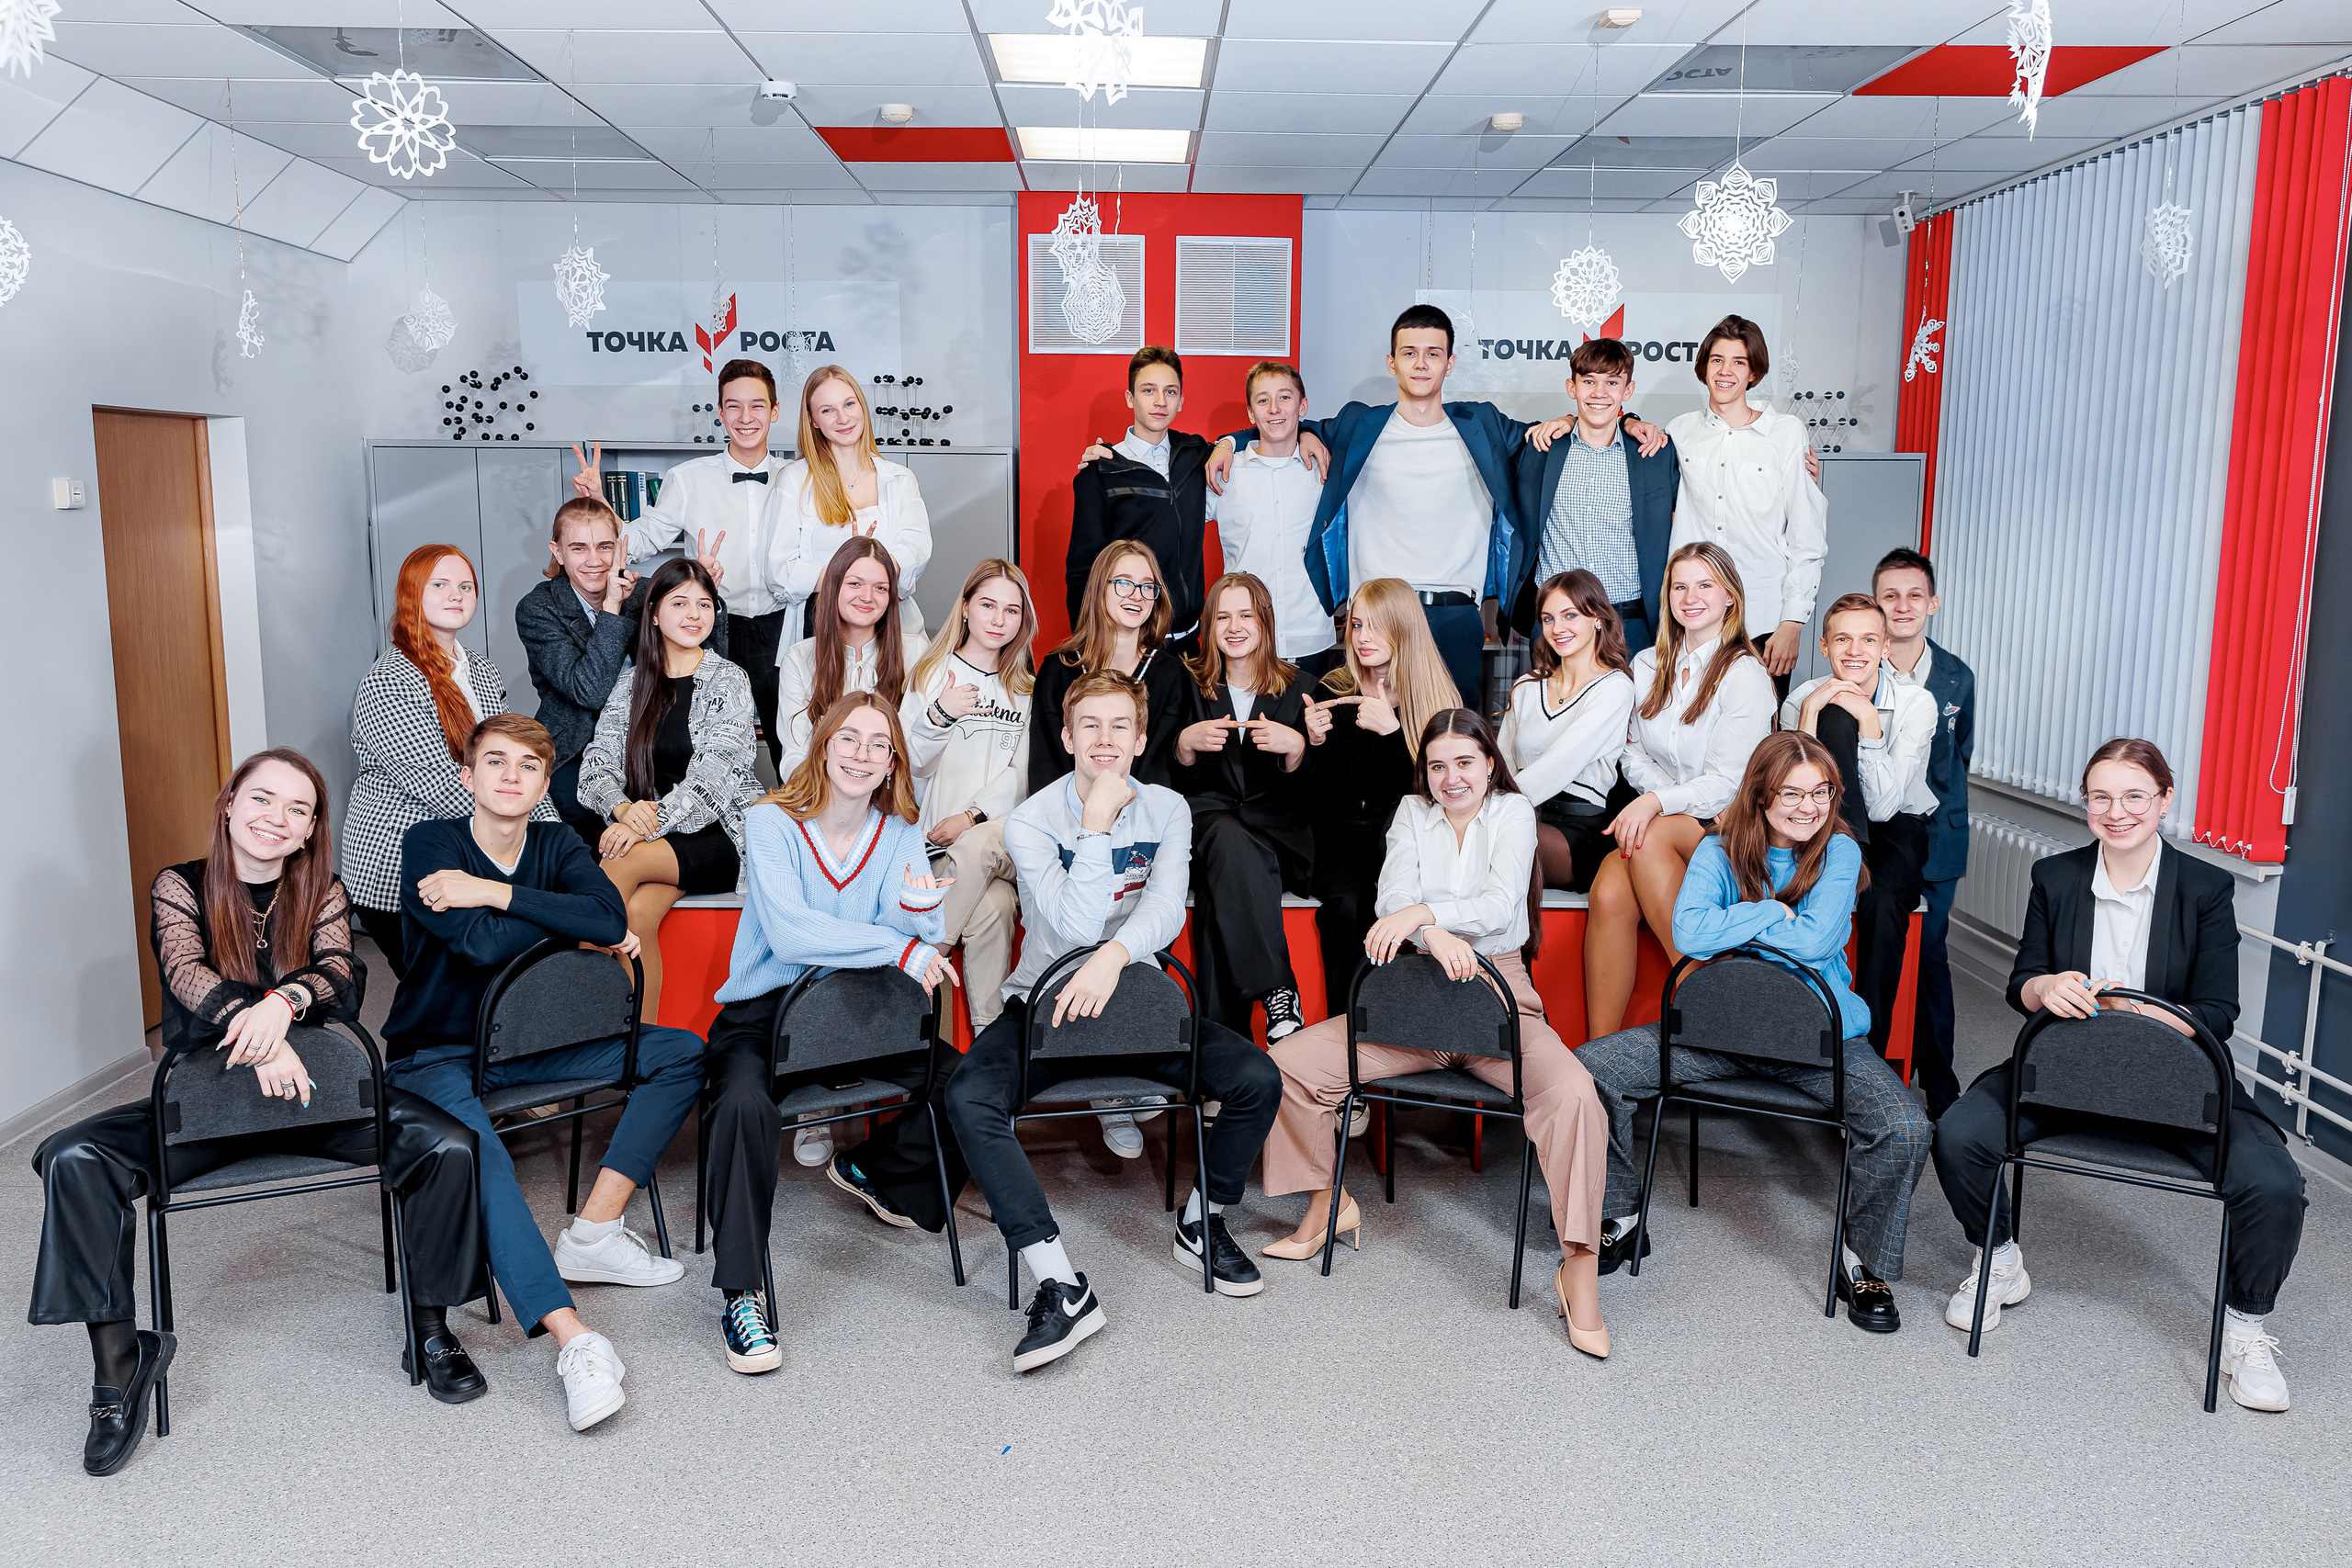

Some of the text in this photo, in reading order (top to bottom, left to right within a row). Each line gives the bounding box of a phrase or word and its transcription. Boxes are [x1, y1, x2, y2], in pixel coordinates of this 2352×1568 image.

[586, 331, 689, 353] ТОЧКА
[1477, 339, 1699, 362] ТОЧКА РОСТ
[1000, 732, 1021, 752] 91
